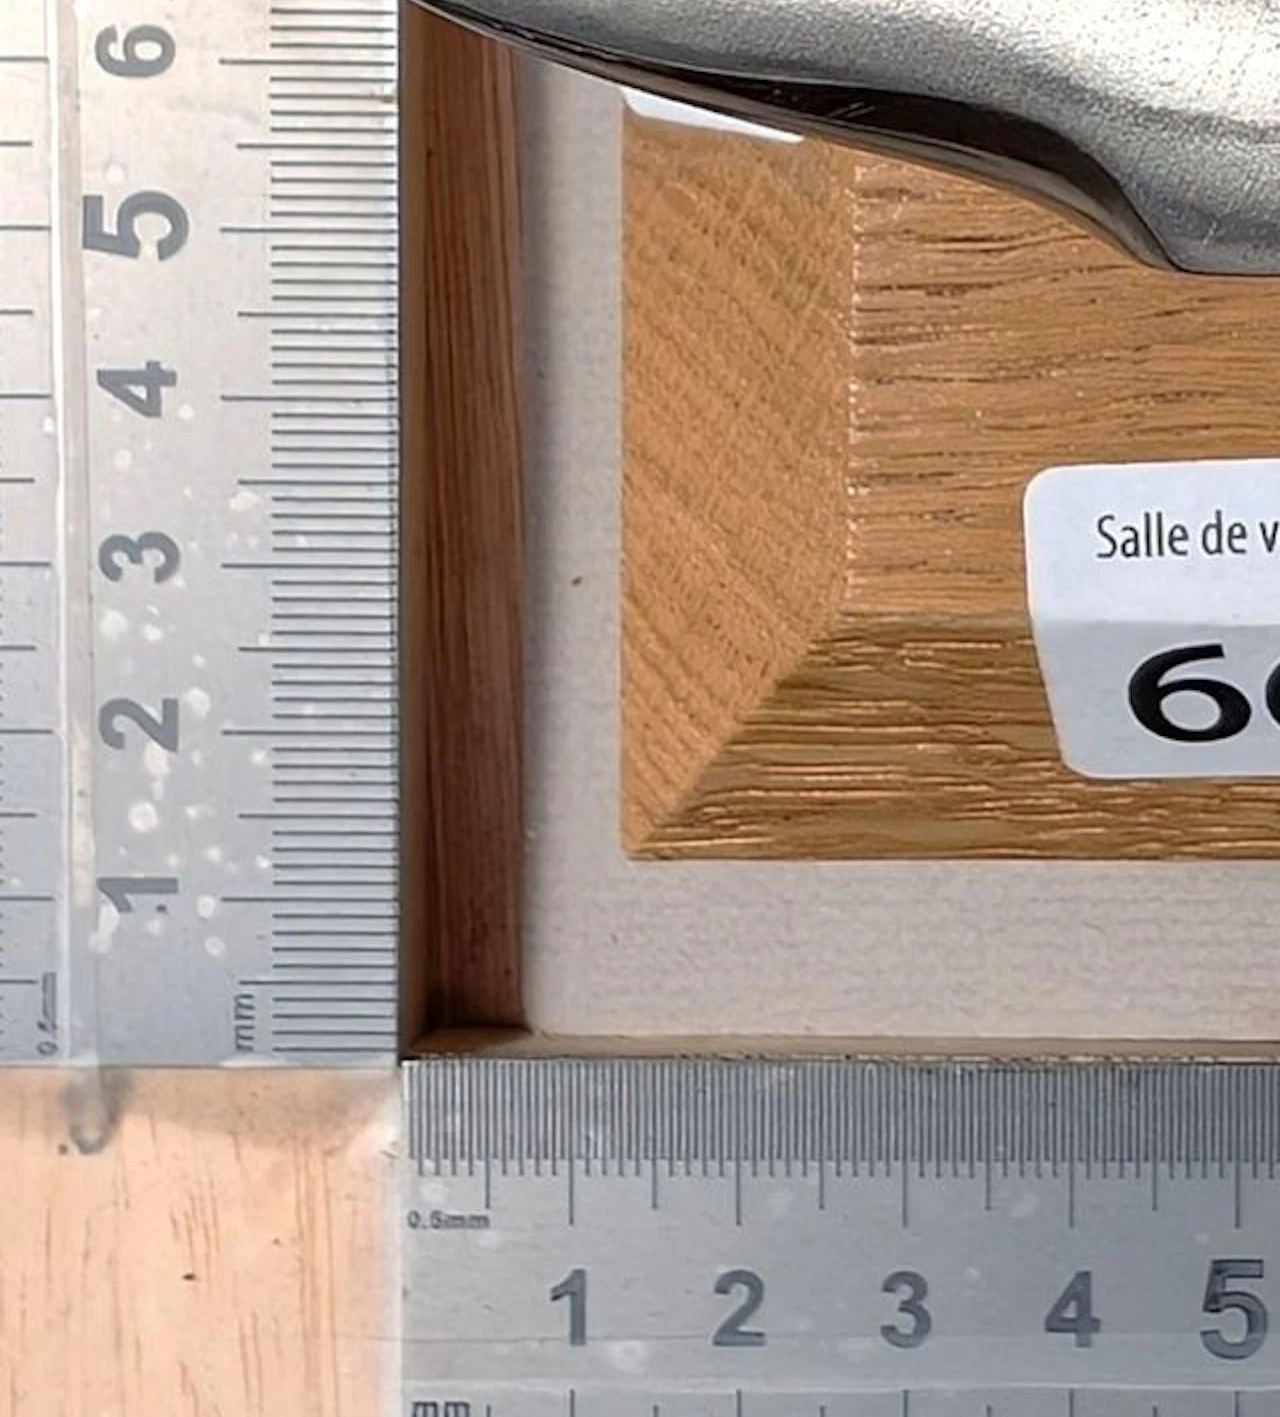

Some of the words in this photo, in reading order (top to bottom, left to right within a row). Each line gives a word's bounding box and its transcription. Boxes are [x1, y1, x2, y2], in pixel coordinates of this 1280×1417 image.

[95, 24, 176, 78] 6
[82, 190, 190, 262] 5
[96, 360, 177, 418] 4
[98, 531, 180, 583] 3
[1096, 512, 1190, 559] Salle
[1200, 509, 1248, 556] de
[98, 697, 178, 752] 2
[96, 877, 179, 913] 1
[234, 993, 255, 1053] mm
[407, 1209, 491, 1230] 0.5mm
[550, 1269, 587, 1347] 1
[712, 1270, 766, 1348] 2
[879, 1271, 932, 1349] 3
[1044, 1270, 1101, 1349] 4
[1200, 1259, 1269, 1359] 5
